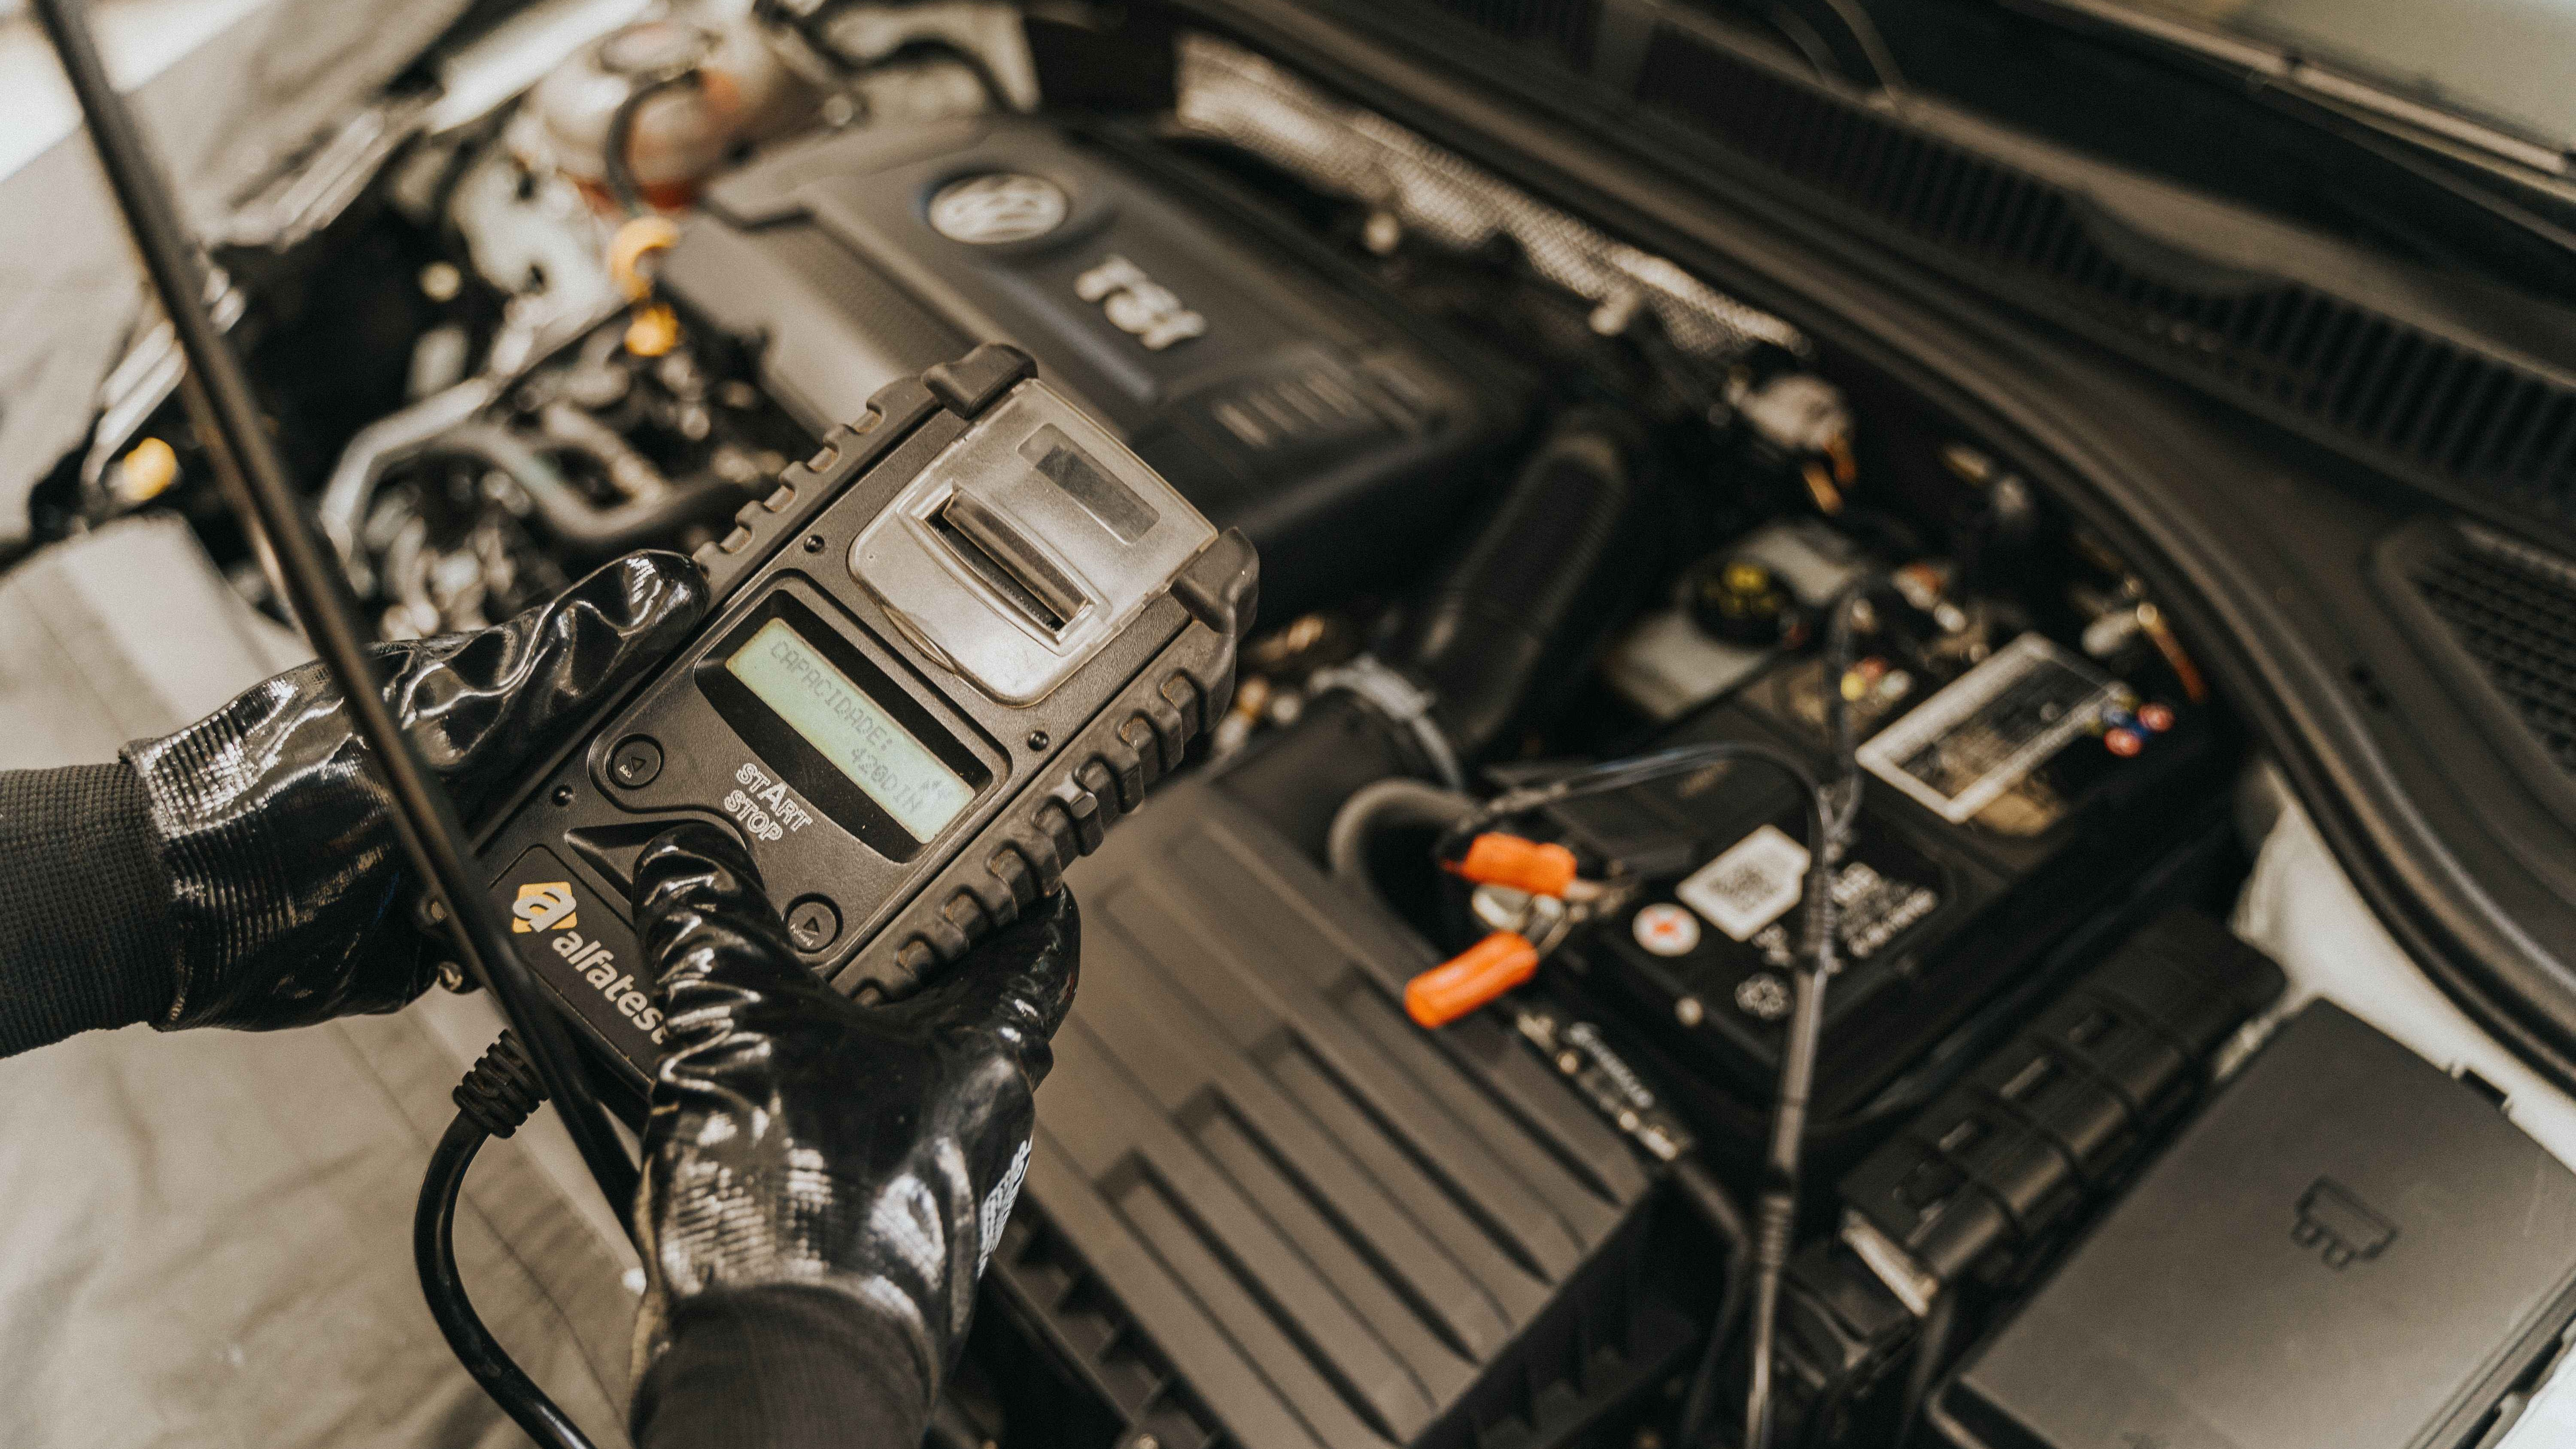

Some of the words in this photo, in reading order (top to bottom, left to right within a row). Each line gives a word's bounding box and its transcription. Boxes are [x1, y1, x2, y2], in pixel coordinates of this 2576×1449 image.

[769, 640, 893, 752] CAPACIDADE:
[724, 789, 783, 841] STOP
[736, 762, 813, 832] START
